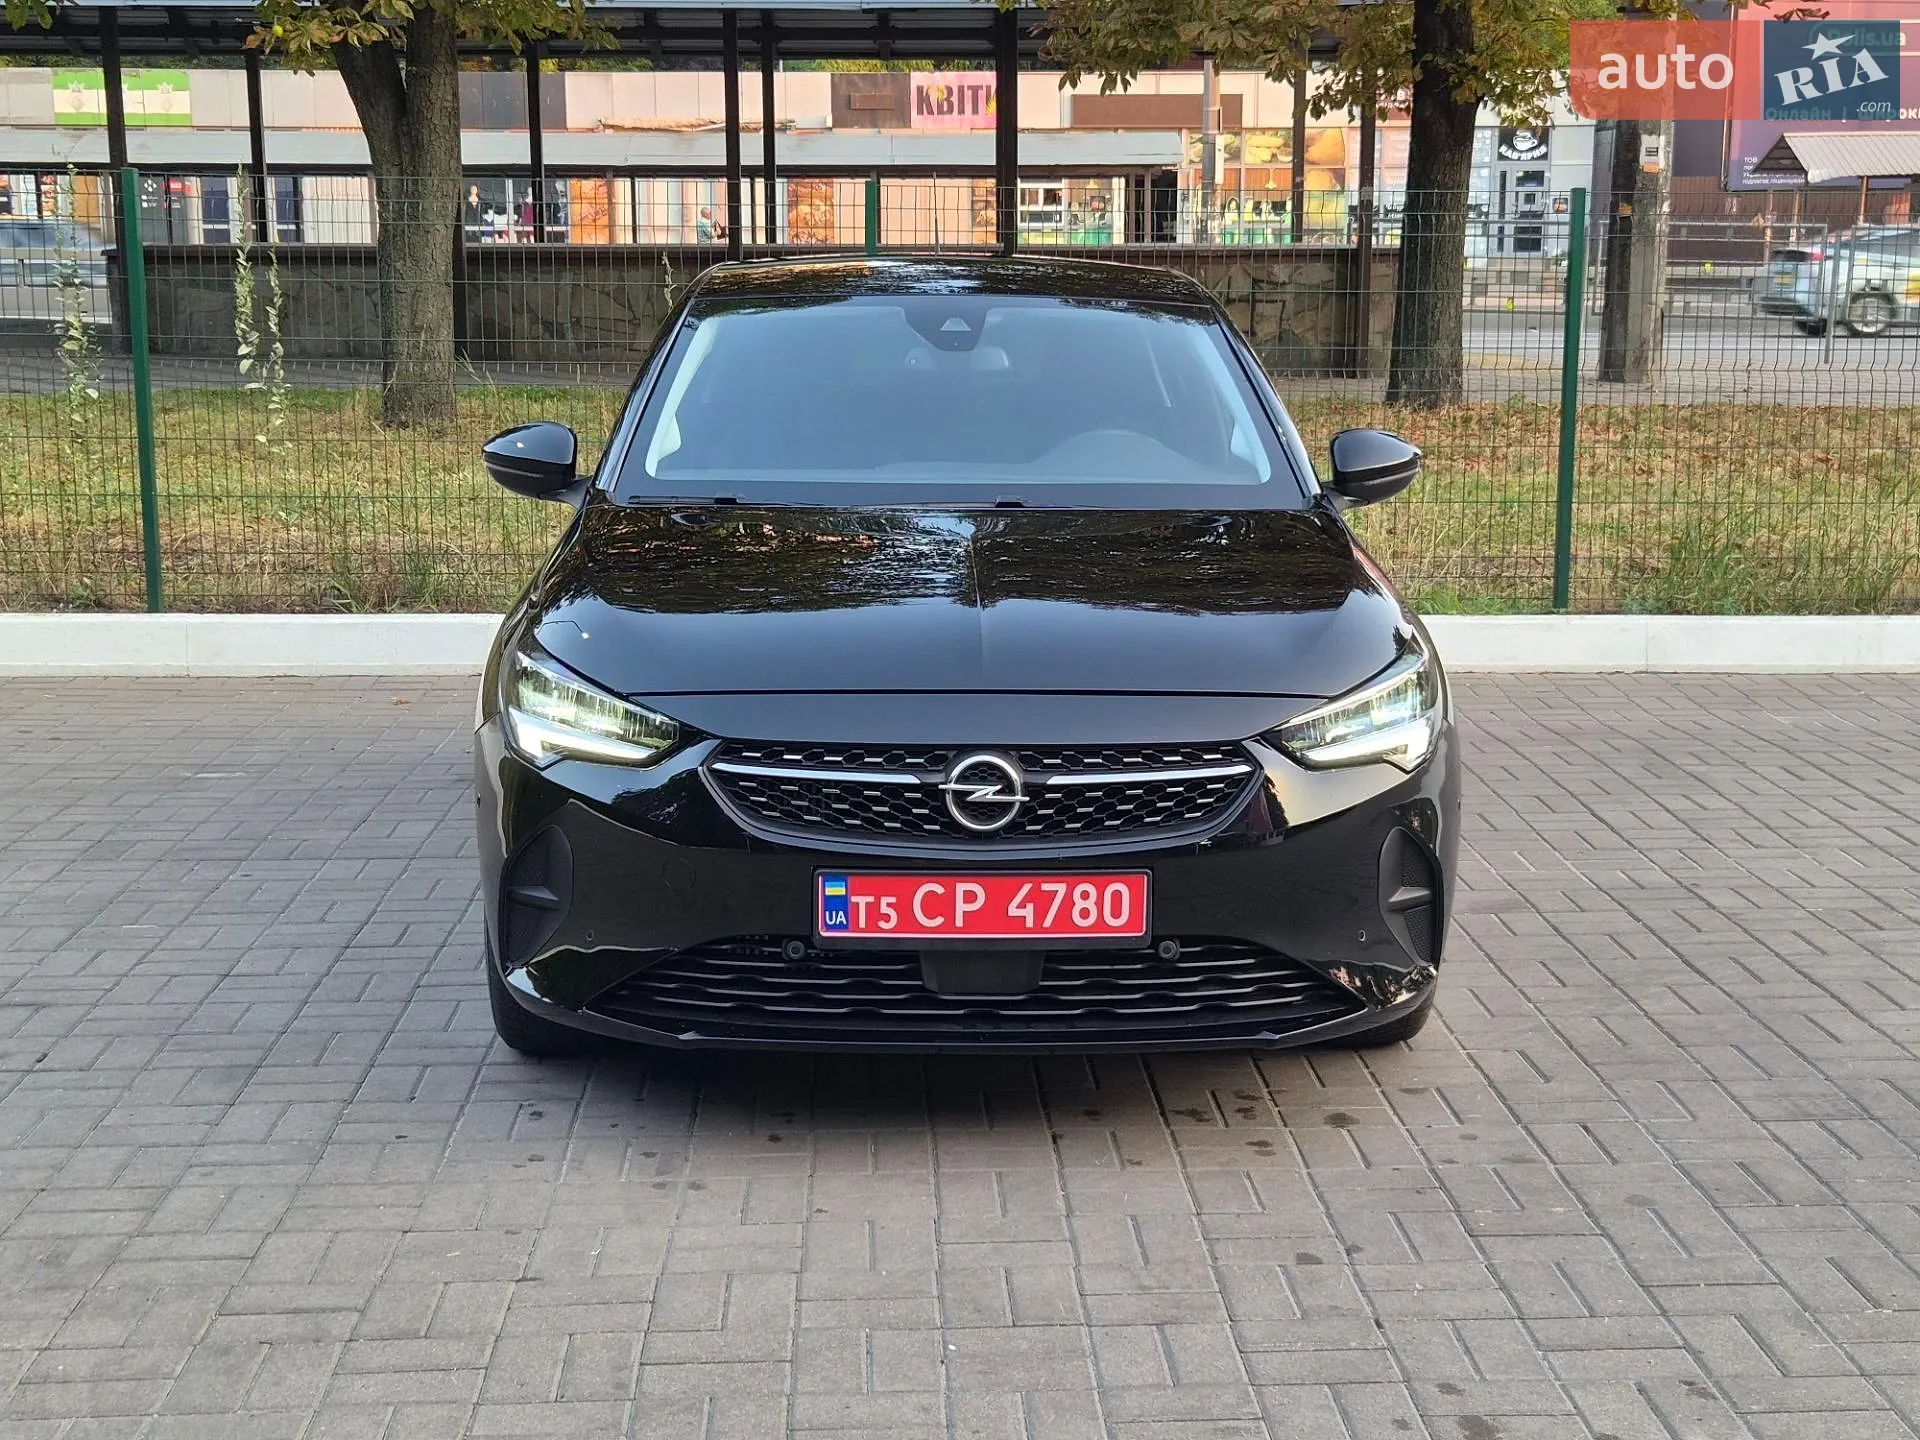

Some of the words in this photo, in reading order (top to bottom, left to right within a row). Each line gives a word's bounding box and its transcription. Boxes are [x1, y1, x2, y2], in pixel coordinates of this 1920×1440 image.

[1857, 106, 1920, 122] широк
[851, 896, 897, 929] T5
[912, 882, 986, 928] CP
[1007, 882, 1130, 928] 4780
[825, 911, 847, 925] UA
